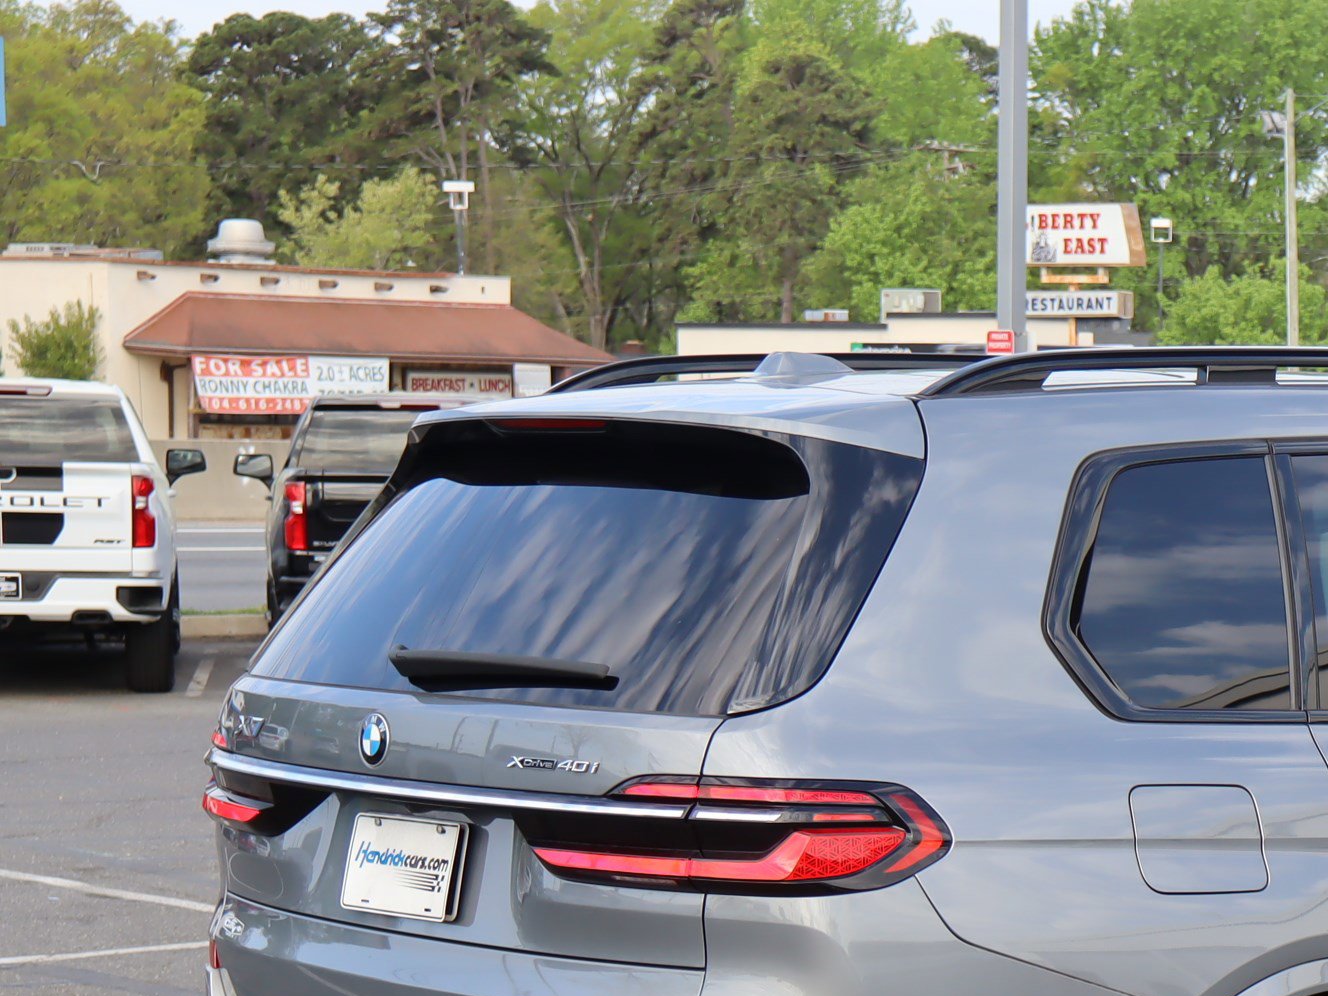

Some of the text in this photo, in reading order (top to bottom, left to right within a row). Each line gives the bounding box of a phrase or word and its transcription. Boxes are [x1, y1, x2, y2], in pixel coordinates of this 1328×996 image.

[1063, 238, 1108, 254] EAST
[195, 358, 308, 377] FOR SALE
[349, 366, 385, 382] ACRES
[200, 378, 249, 394] RONNY
[253, 379, 309, 394] CHAKRA
[411, 378, 511, 393] BREAKFAST LUNCH
[0, 496, 111, 508] OLET
